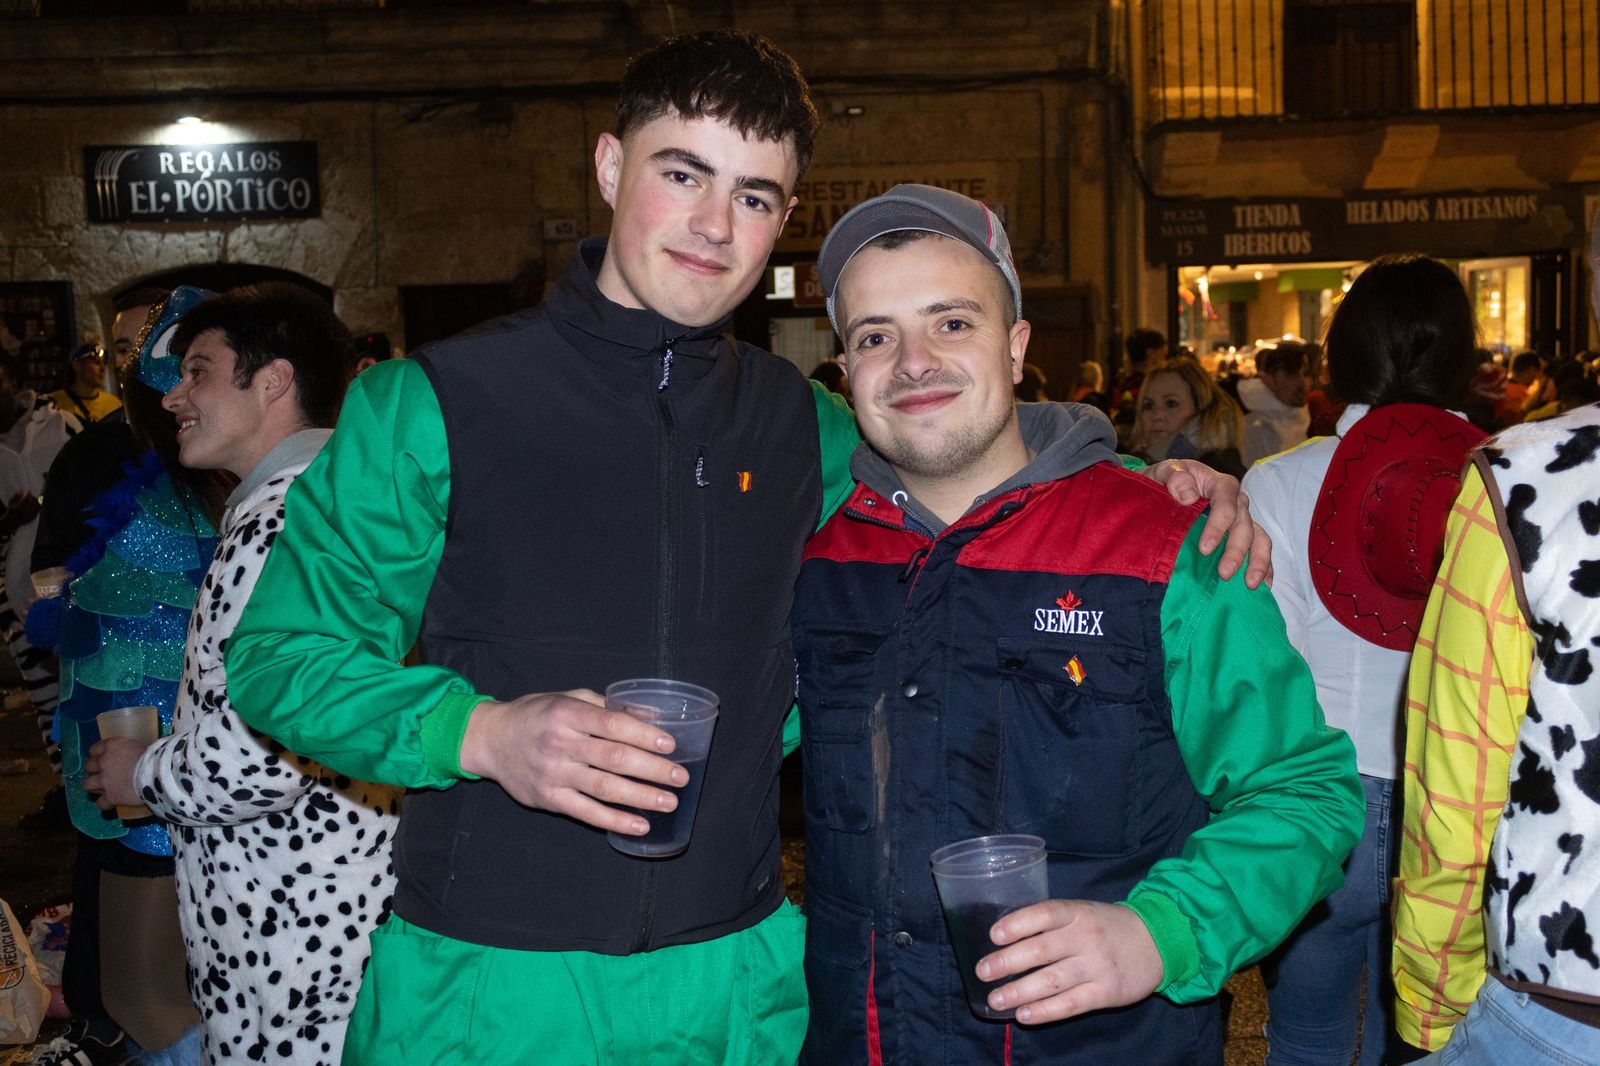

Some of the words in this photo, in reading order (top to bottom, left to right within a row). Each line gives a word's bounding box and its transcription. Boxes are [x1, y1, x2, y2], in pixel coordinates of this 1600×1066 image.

[159, 150, 282, 176] REGALOS
[796, 177, 986, 200] RESTANTE
[1232, 203, 1302, 228] TIENDA
[1346, 198, 1430, 224] HELADOS
[1434, 194, 1538, 221] ARTESANOS
[1176, 240, 1194, 256] 15
[1034, 608, 1104, 636] SEMEX
